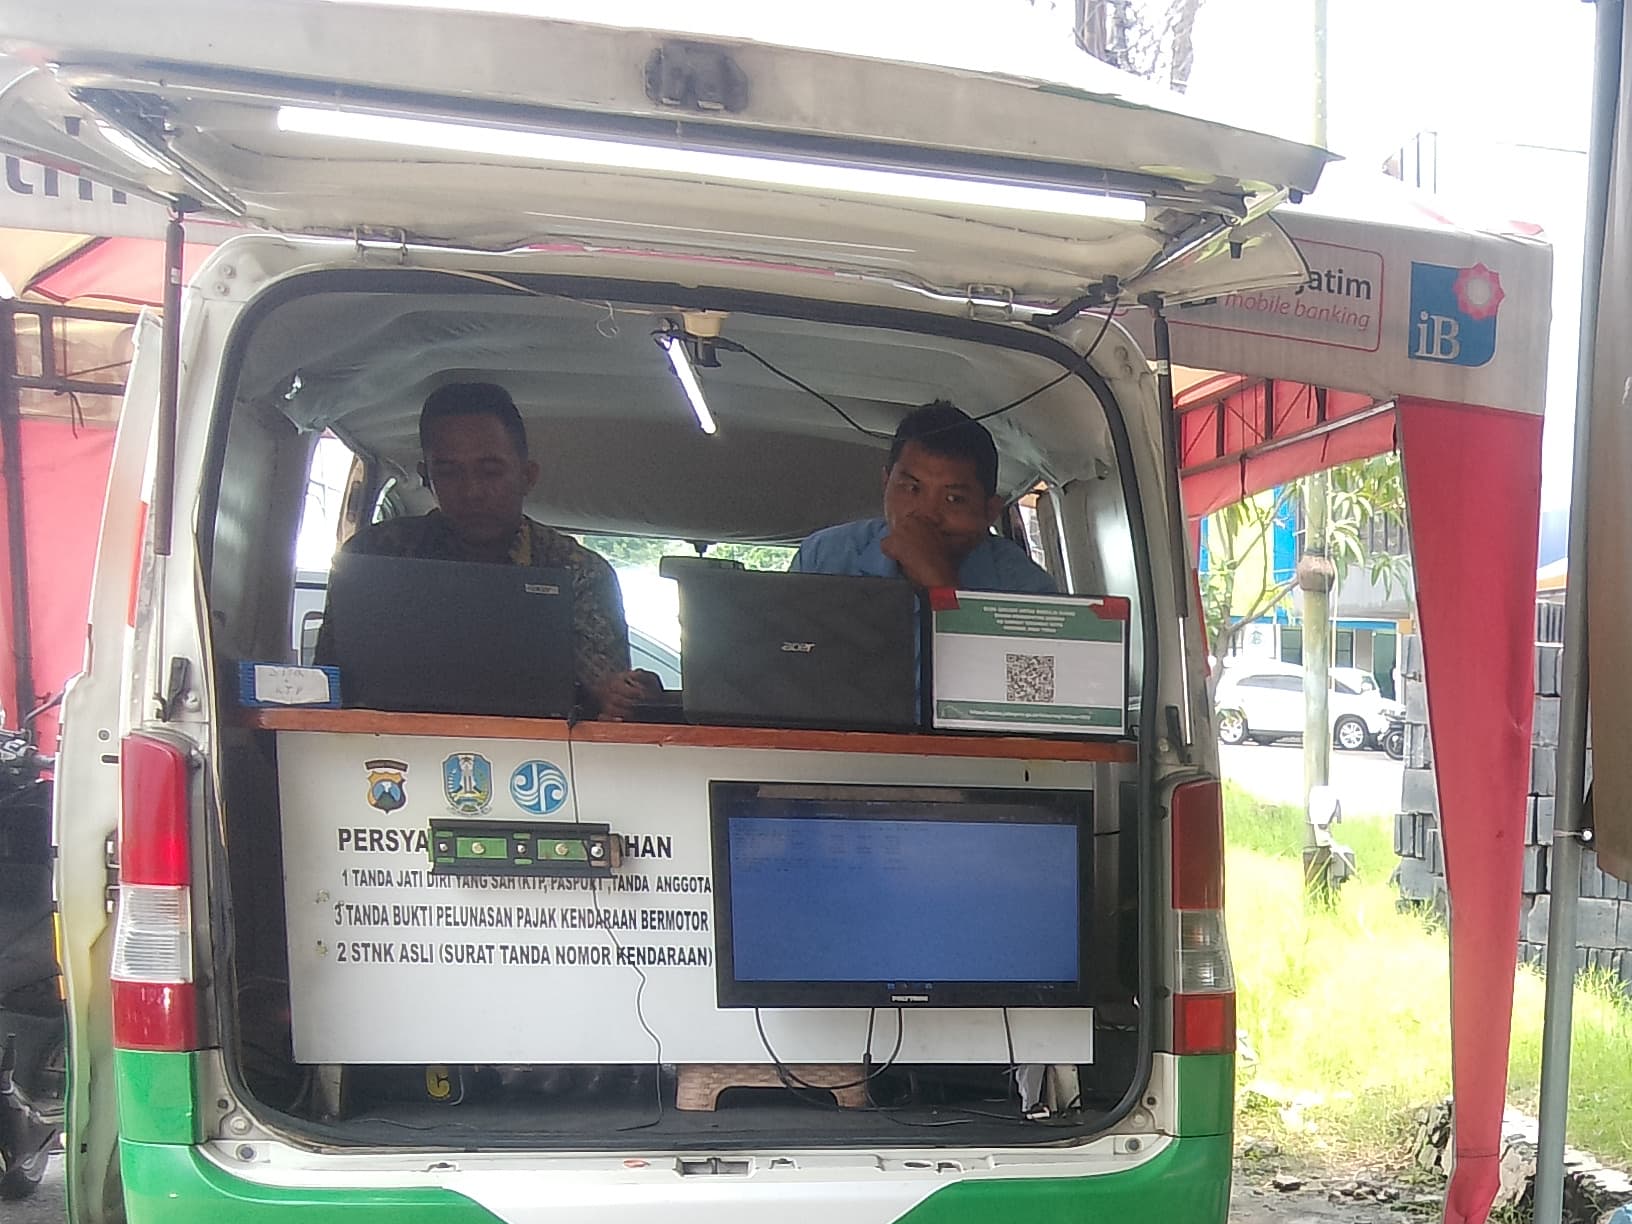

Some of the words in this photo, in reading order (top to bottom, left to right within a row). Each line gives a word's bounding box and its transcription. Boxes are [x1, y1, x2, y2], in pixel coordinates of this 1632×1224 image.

[1296, 268, 1371, 300] atim
[1224, 293, 1290, 316] mobile
[1295, 299, 1370, 332] banking
[1414, 311, 1461, 360] iB
[780, 641, 816, 652] acer
[342, 869, 348, 887] 1
[352, 869, 394, 887] TANDA
[397, 870, 423, 888] JATI
[427, 871, 450, 888] DIRI
[456, 874, 488, 889] YANG
[491, 875, 516, 890] SAH
[656, 876, 712, 893] ANGGOTA
[334, 904, 342, 925] 3
[346, 904, 389, 926] TANDA
[393, 905, 433, 927] BUKTI
[437, 906, 513, 928] PELUNASAN
[517, 907, 556, 929] PAJAK
[561, 908, 637, 930] KENDARAAN
[641, 910, 709, 931] BERMOTOR
[337, 942, 346, 962] 2
[351, 943, 394, 962] STNK
[399, 943, 434, 963] ASLI
[439, 944, 495, 964] (SURAT
[499, 945, 550, 965] TANDA
[556, 946, 611, 965] NOMOR
[616, 946, 713, 967] KENDARAAN)
